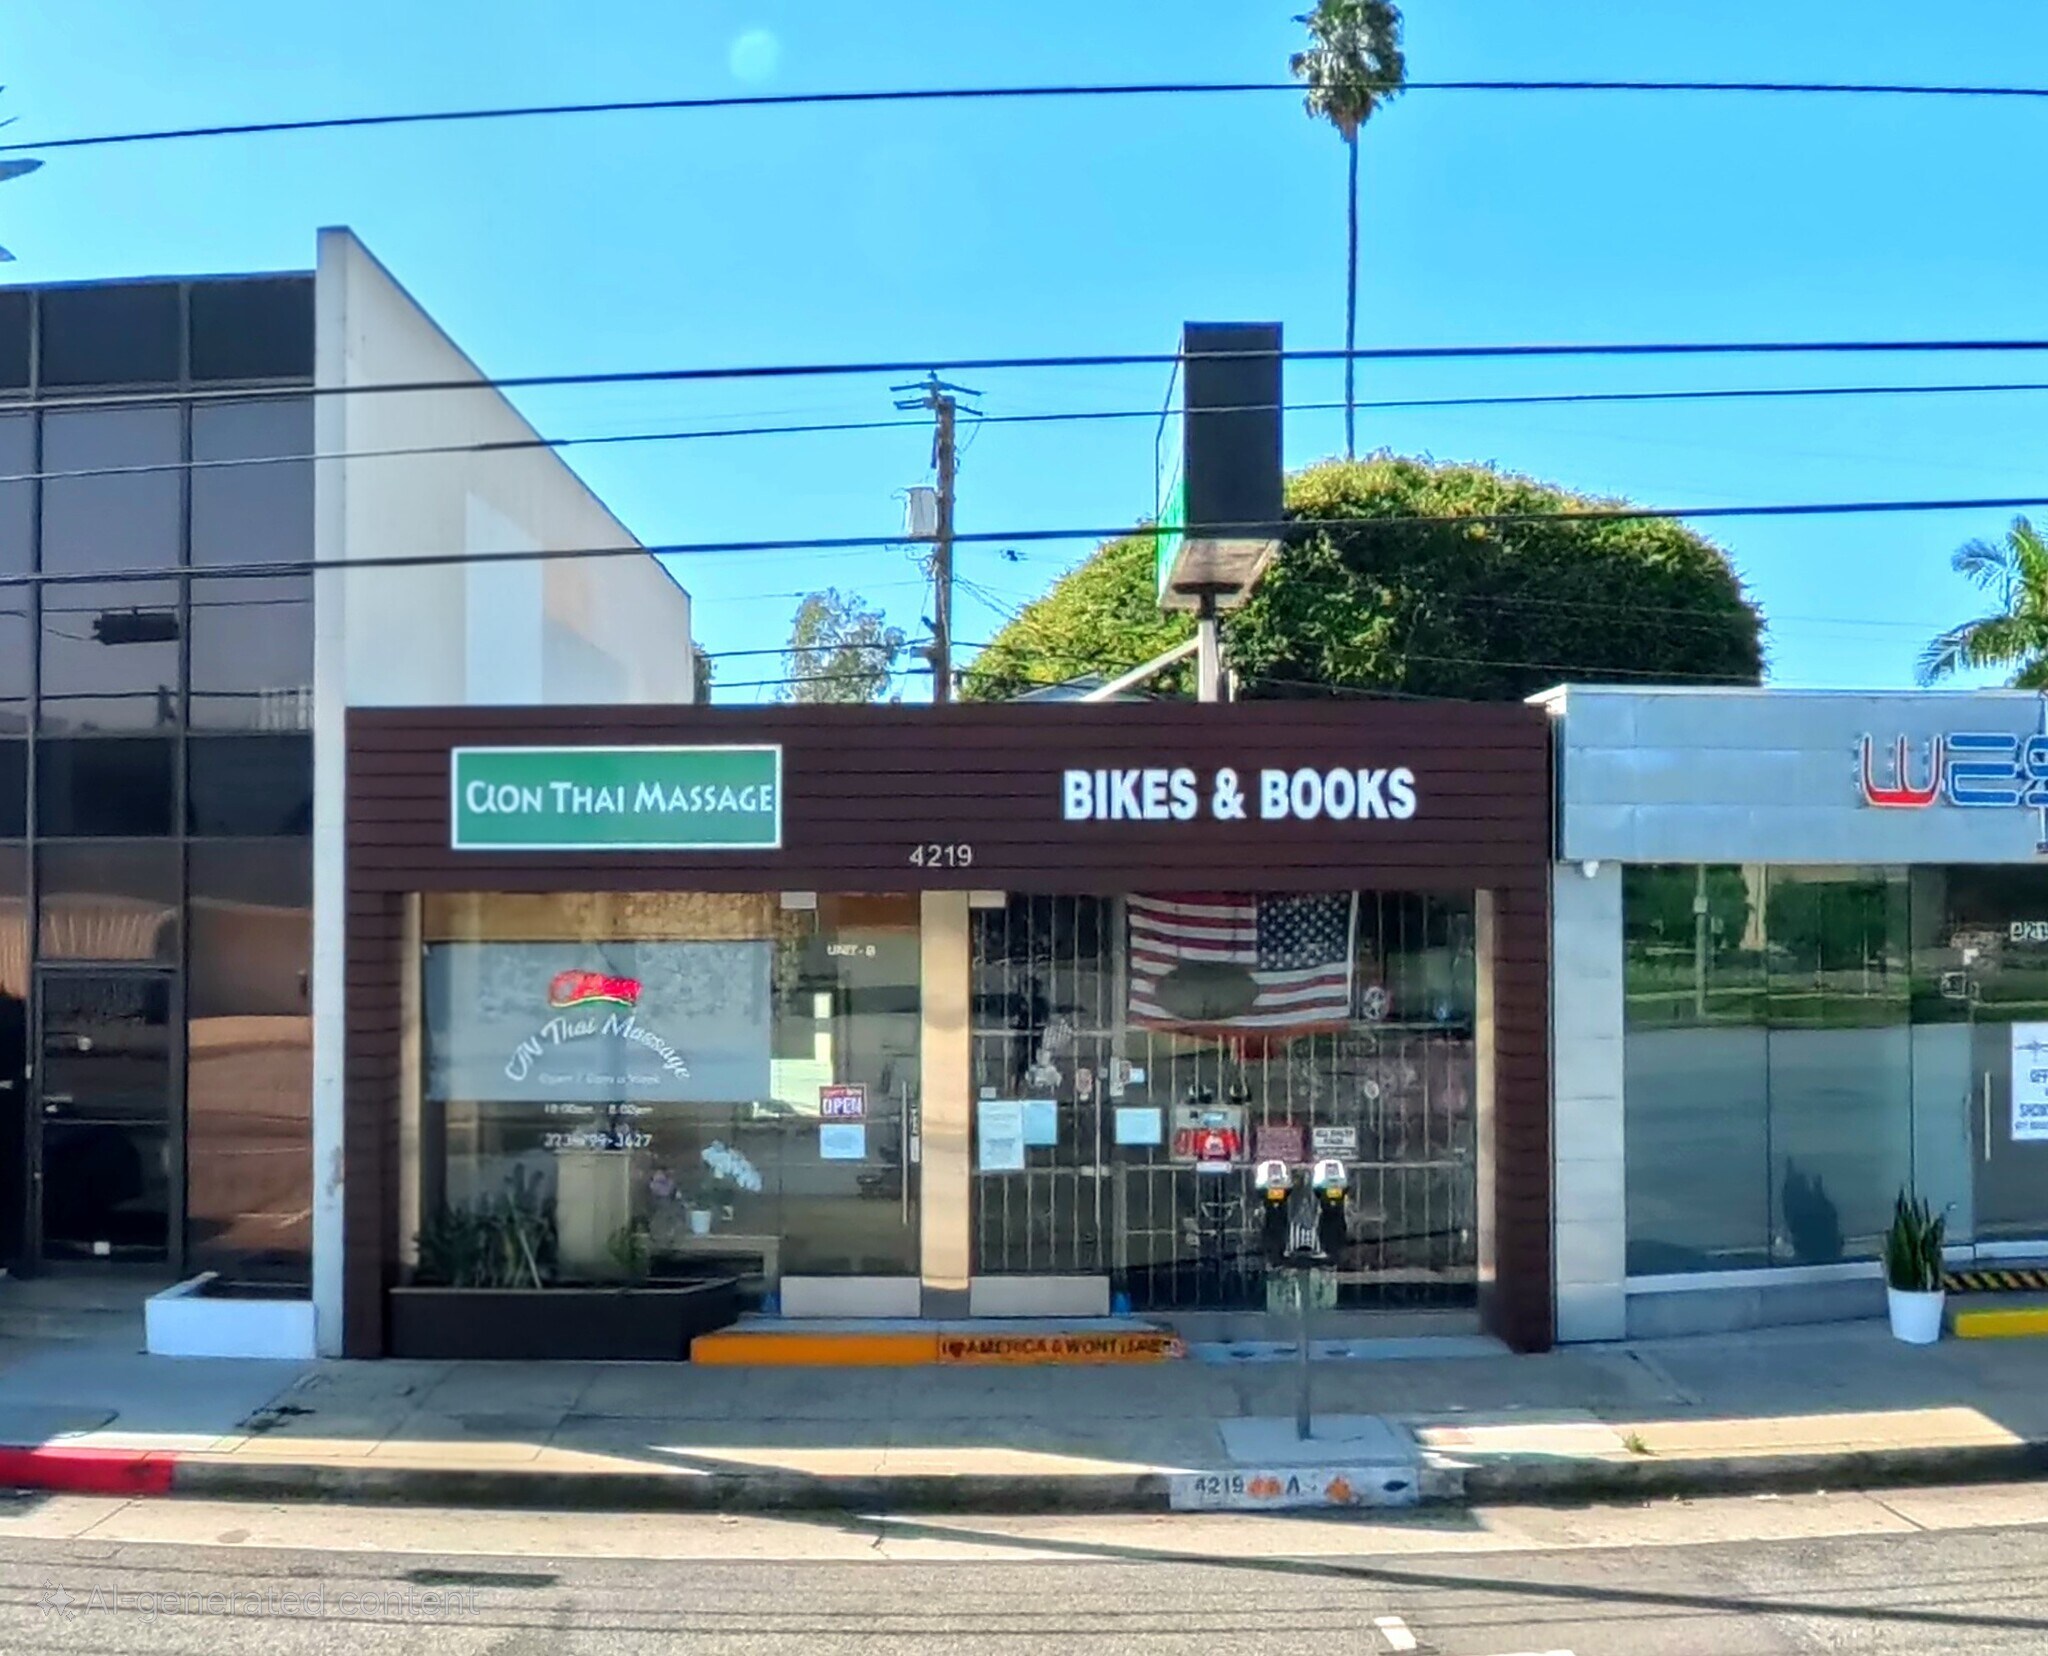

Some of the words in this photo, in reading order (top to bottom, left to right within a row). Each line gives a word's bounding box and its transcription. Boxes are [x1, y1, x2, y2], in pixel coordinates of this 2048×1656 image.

[549, 781, 625, 813] THAI
[633, 782, 773, 812] MASSAGE
[1064, 768, 1198, 820] BIKES
[1212, 767, 1247, 820] &
[1260, 767, 1417, 820] BOOKS
[909, 844, 972, 867] 4219
[822, 1097, 862, 1115] OPEN
